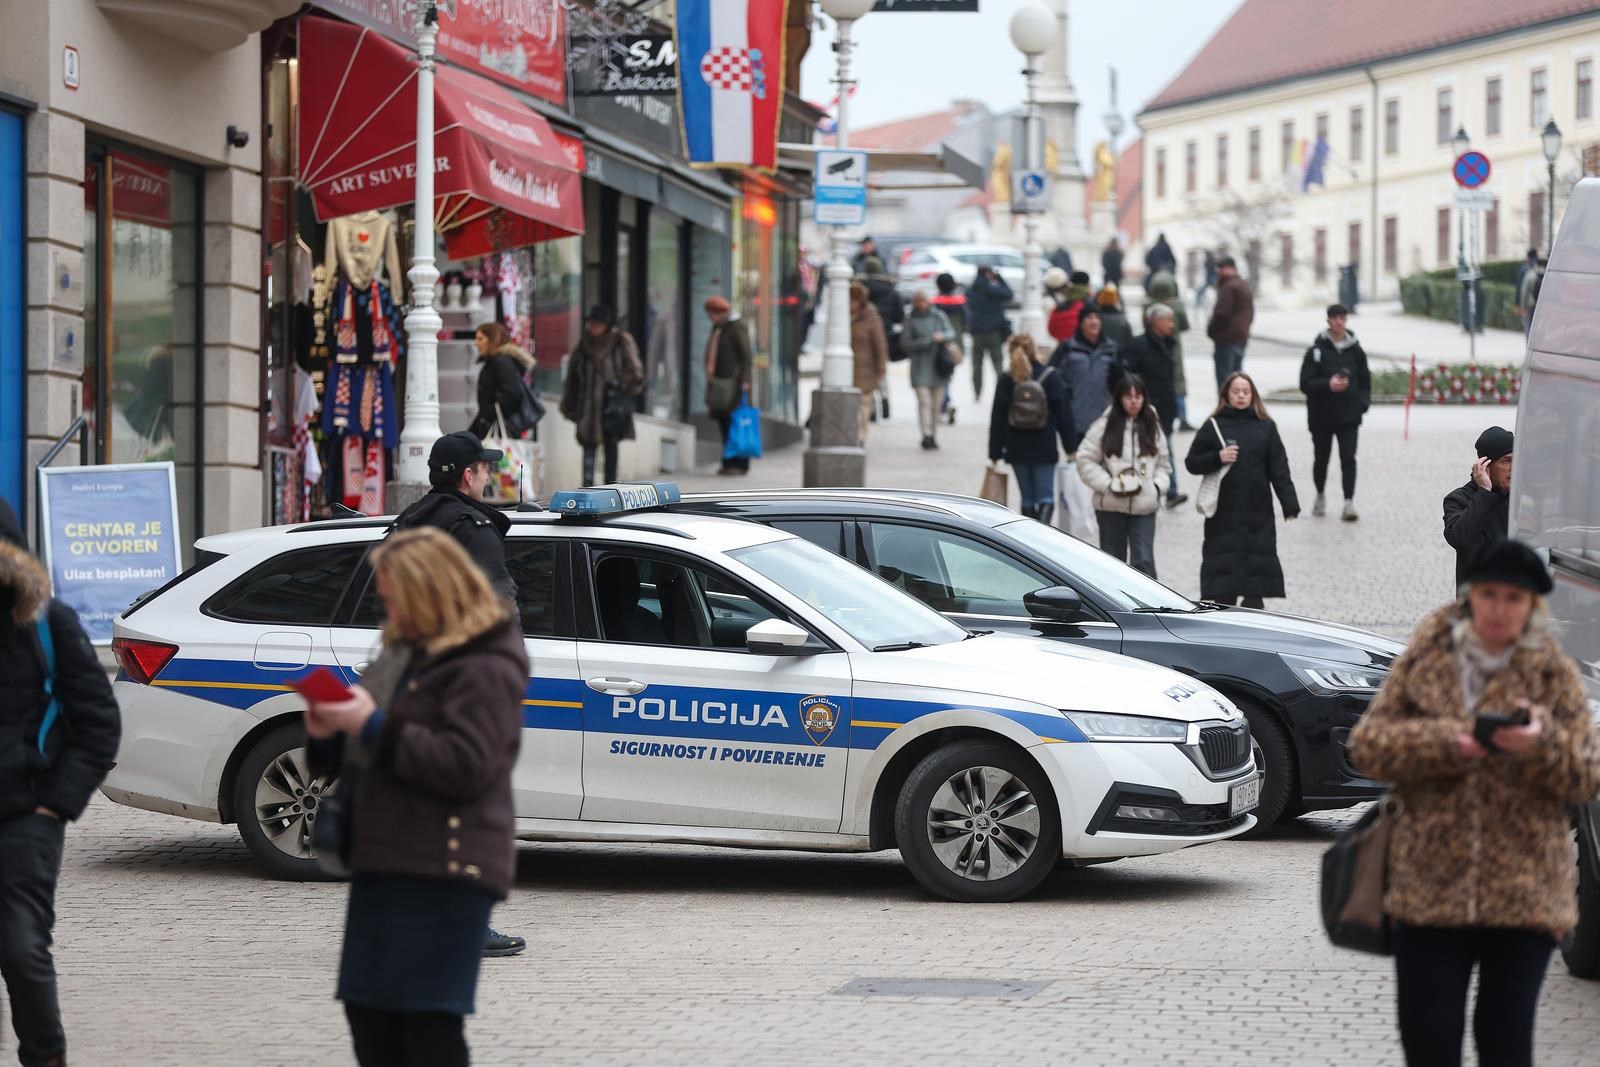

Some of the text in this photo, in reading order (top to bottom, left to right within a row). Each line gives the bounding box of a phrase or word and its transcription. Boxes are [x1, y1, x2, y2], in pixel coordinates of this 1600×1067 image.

[329, 173, 365, 196] ART
[623, 489, 656, 508] POLICIJA
[64, 520, 162, 538] CENTAR JE
[70, 539, 158, 555] OTVOREN
[64, 566, 165, 581] Ulaz besplatan!
[612, 696, 789, 728] POLICIJA
[803, 697, 838, 709] POLICIJA
[610, 740, 826, 768] SIGURNOST I POVJERENJE
